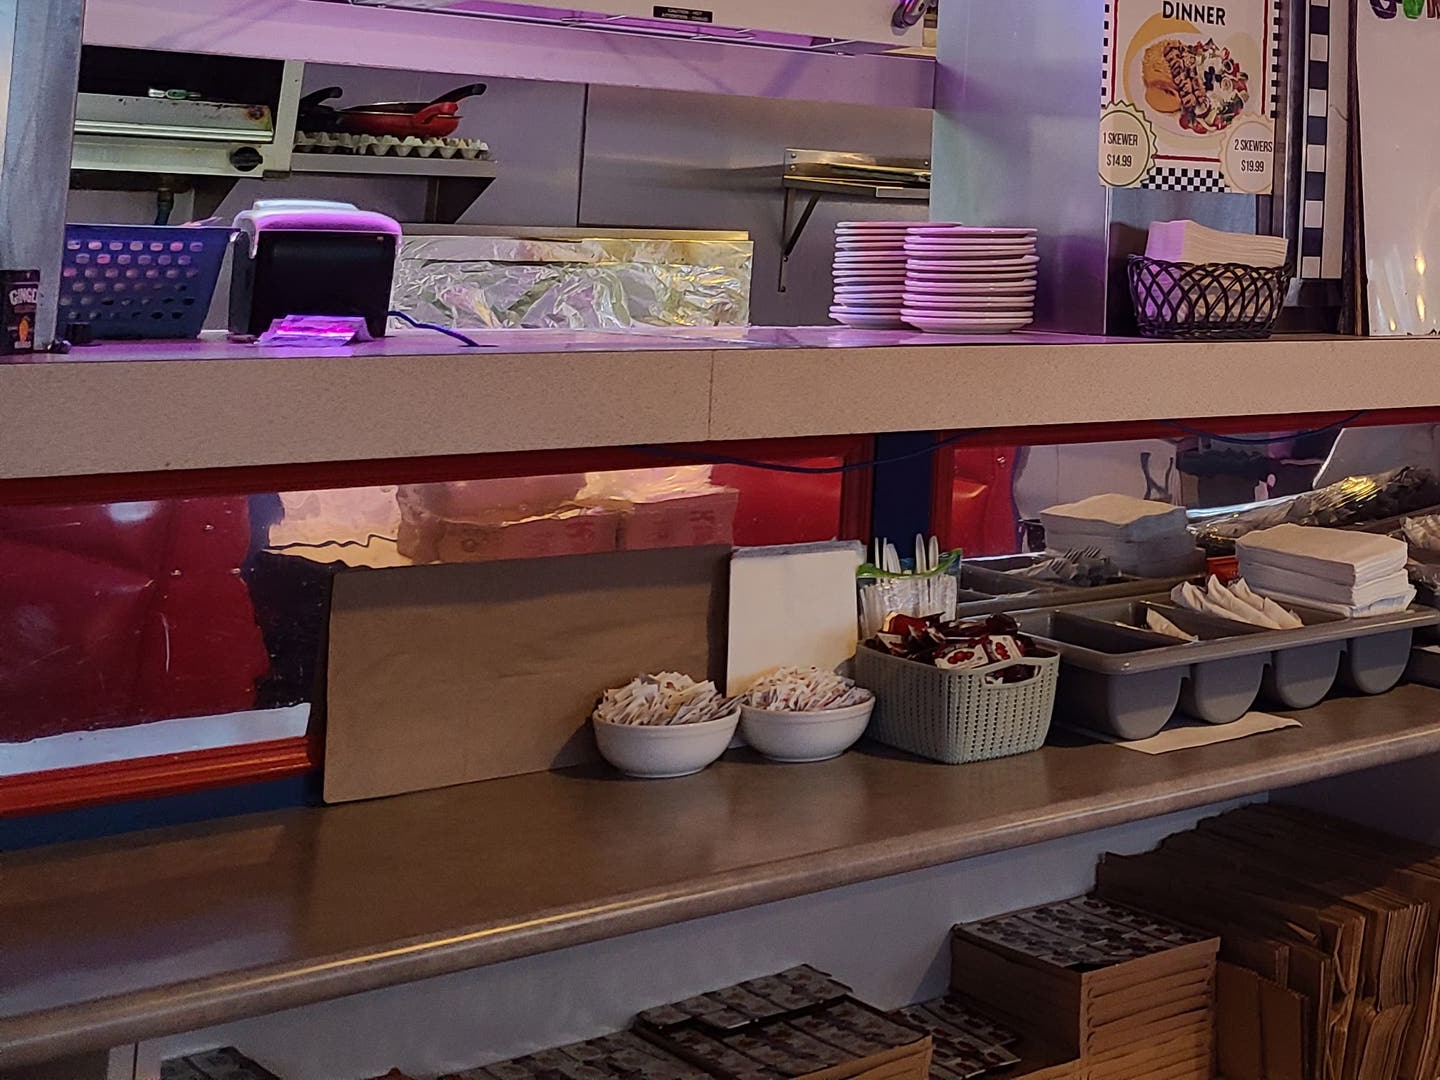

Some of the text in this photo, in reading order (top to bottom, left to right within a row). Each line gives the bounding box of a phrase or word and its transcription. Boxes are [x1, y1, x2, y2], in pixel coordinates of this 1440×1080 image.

[1162, 0, 1226, 26] DINNER
[1107, 132, 1138, 146] SKEWER
[1234, 139, 1273, 153] 2 SKEWERS
[1106, 154, 1132, 167] $14.99
[1241, 160, 1265, 172] $19.99
